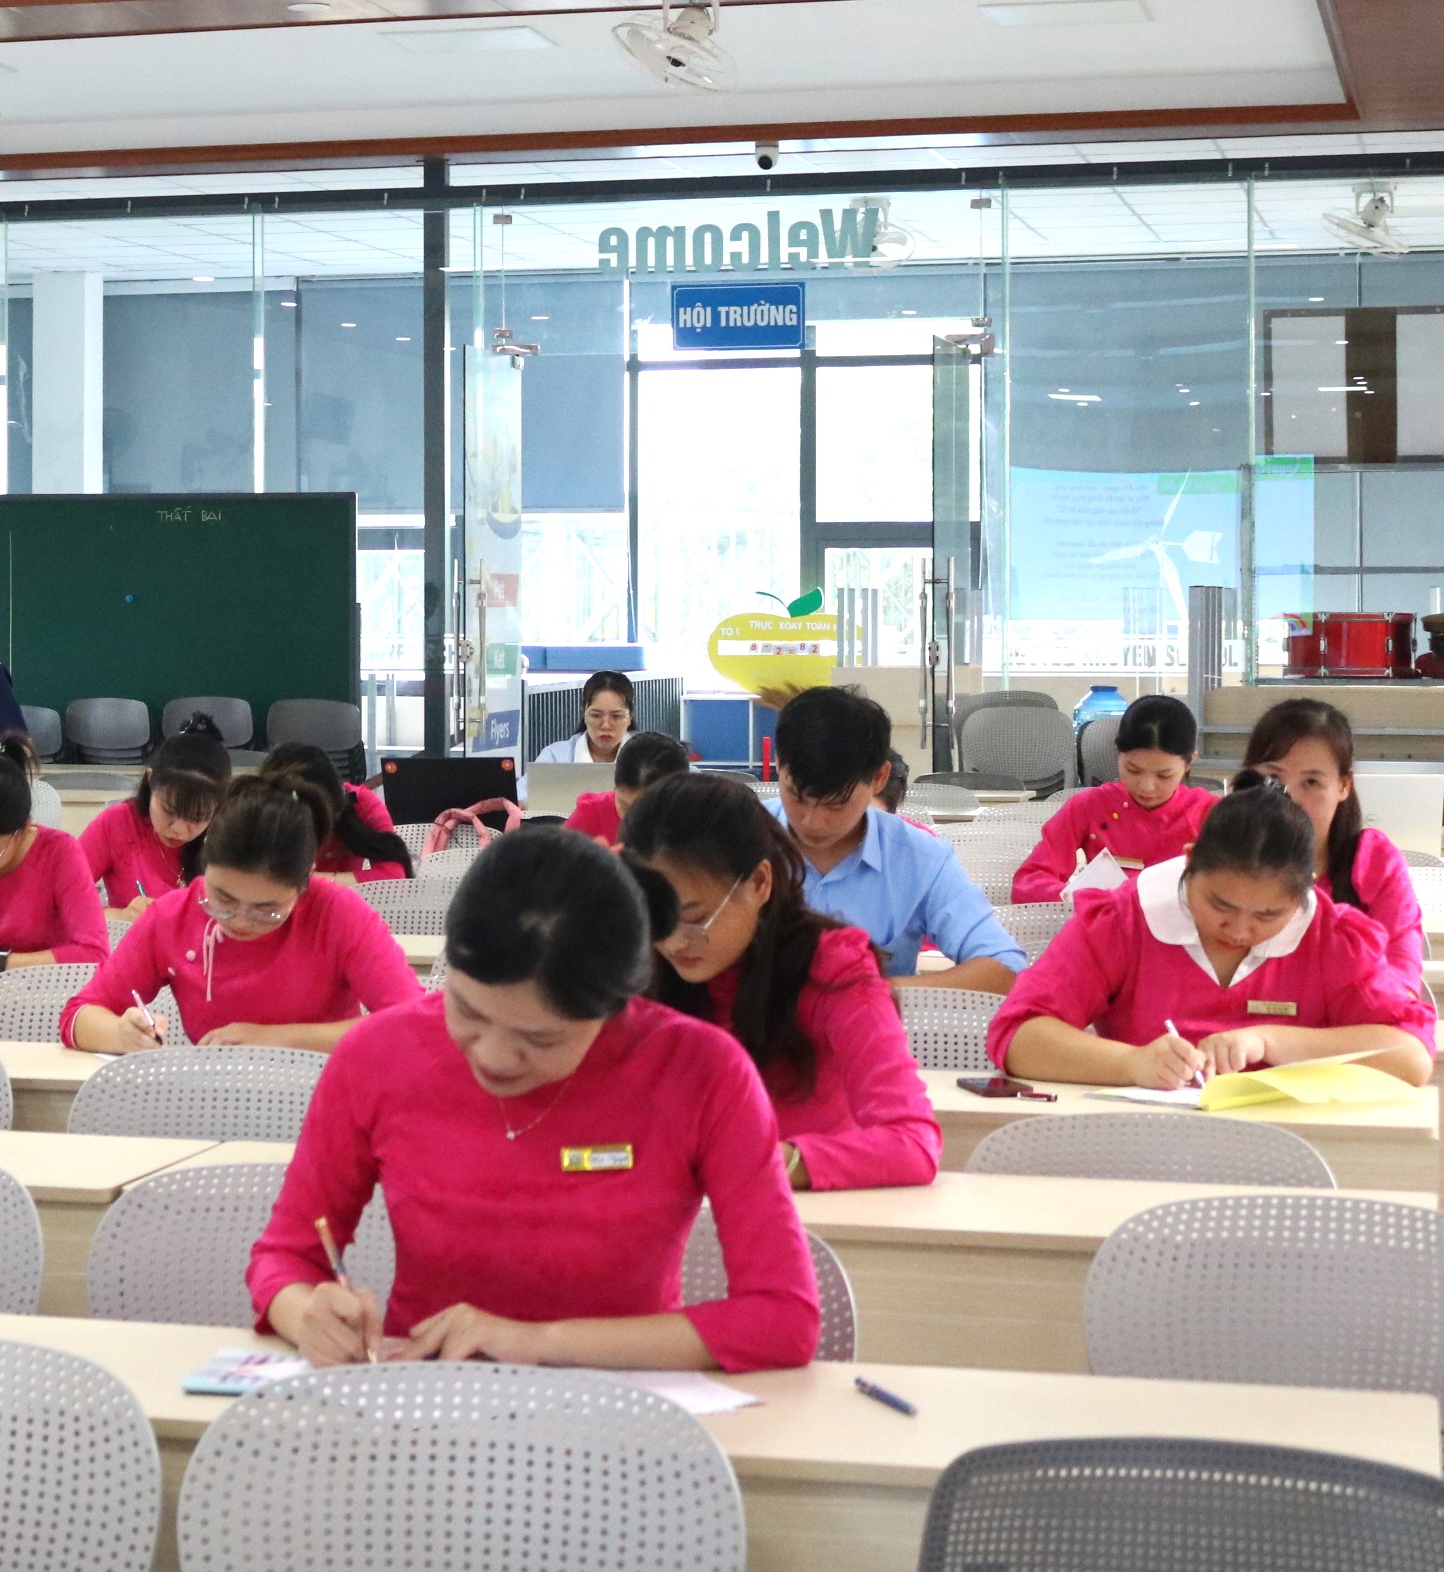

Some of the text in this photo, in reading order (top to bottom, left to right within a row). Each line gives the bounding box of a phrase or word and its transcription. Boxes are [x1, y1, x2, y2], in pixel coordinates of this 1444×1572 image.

[679, 300, 797, 332] HỘI TRƯỜNG
[490, 719, 510, 746] Flyers
